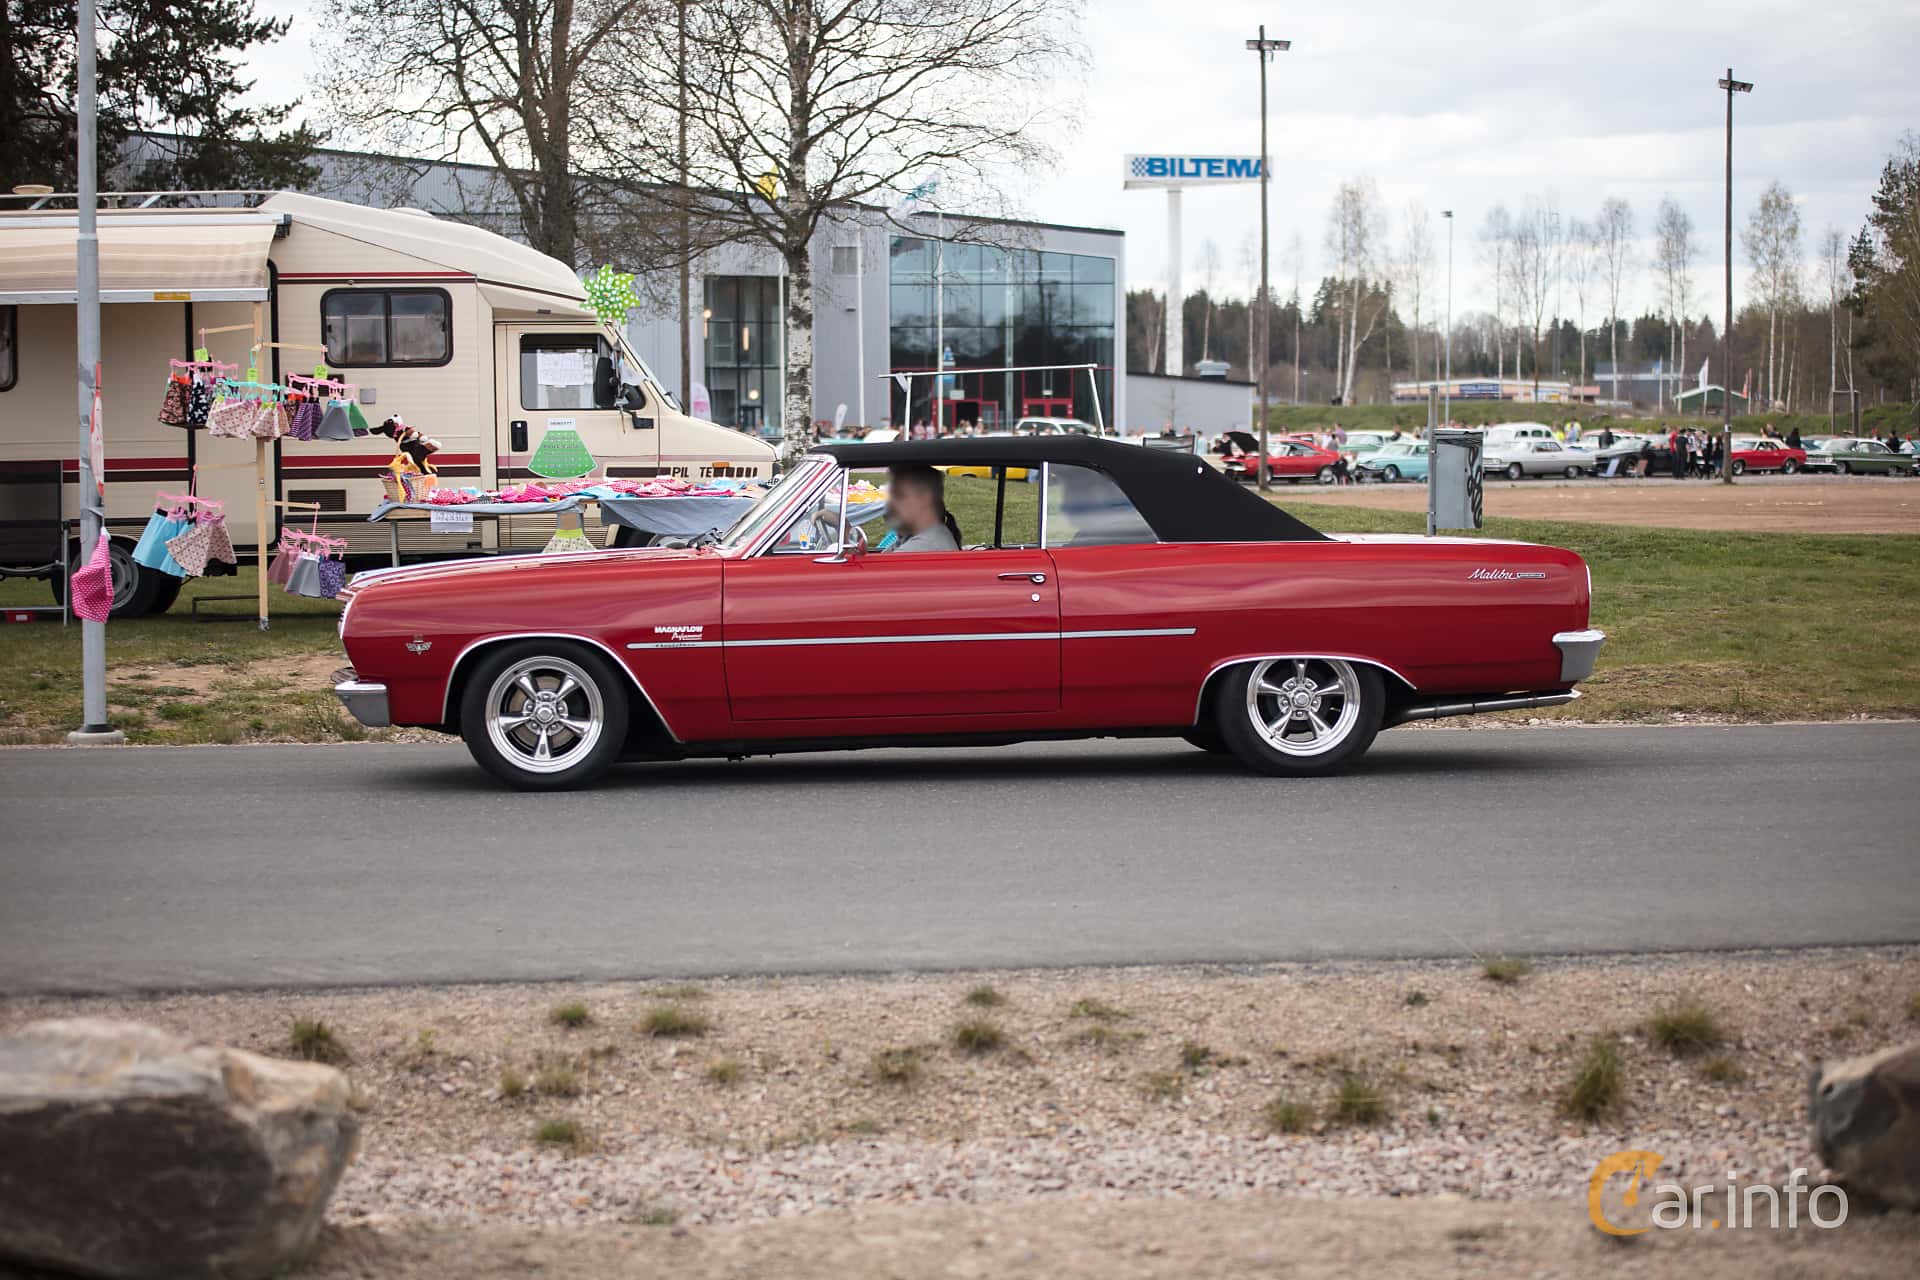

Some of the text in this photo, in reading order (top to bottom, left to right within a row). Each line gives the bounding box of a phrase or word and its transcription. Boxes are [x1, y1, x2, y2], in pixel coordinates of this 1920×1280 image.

[1148, 157, 1271, 178] BILTEMA
[1467, 568, 1517, 580] Malibu
[654, 625, 704, 634] MAGNAFLOW
